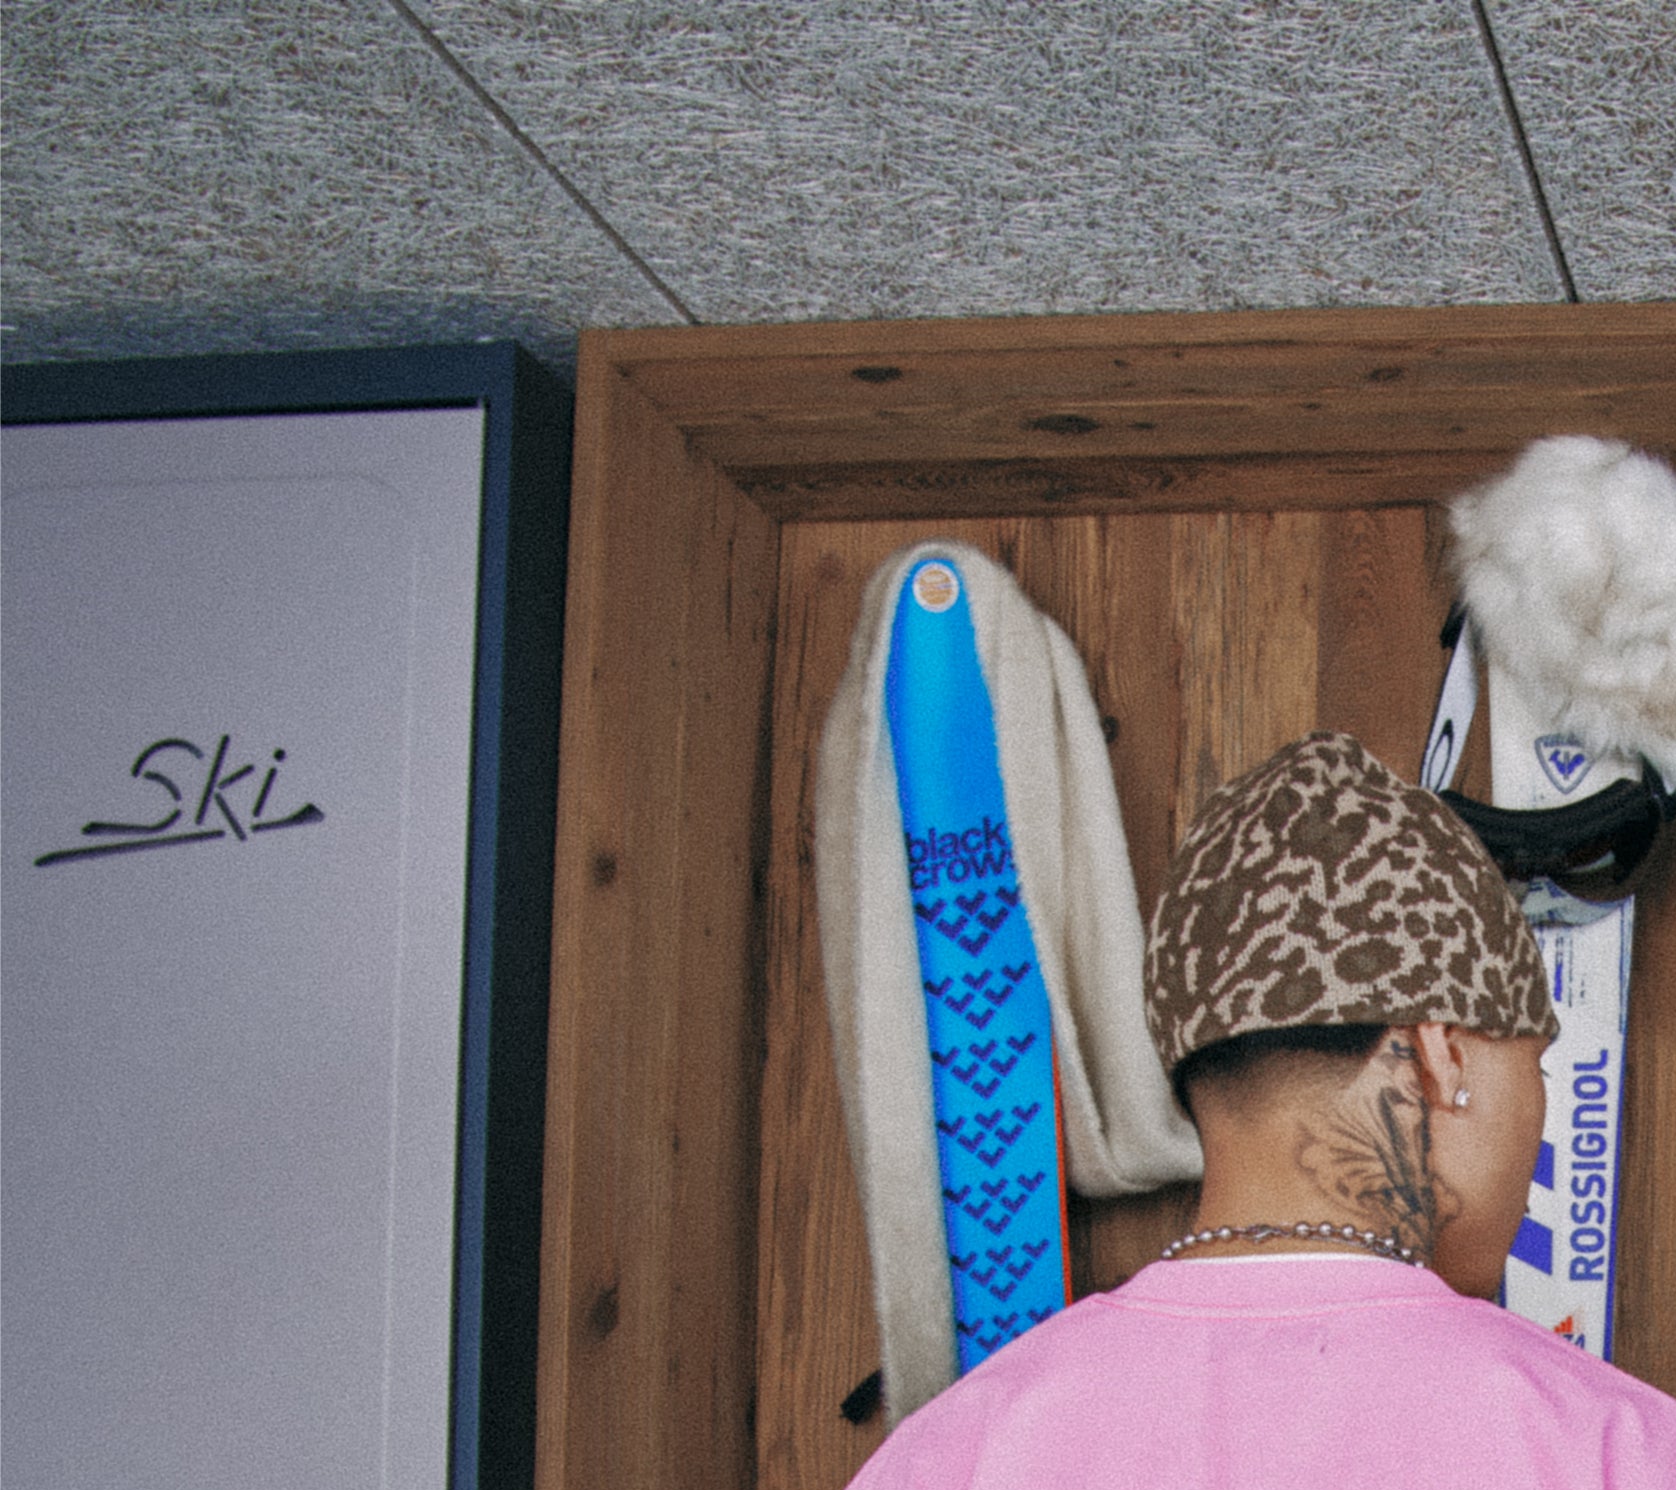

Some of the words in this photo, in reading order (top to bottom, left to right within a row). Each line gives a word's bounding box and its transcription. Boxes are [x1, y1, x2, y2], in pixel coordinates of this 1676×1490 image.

[82, 733, 288, 842] Ski
[905, 816, 1006, 866] black
[1569, 1048, 1608, 1282] ROSSIGNOL
